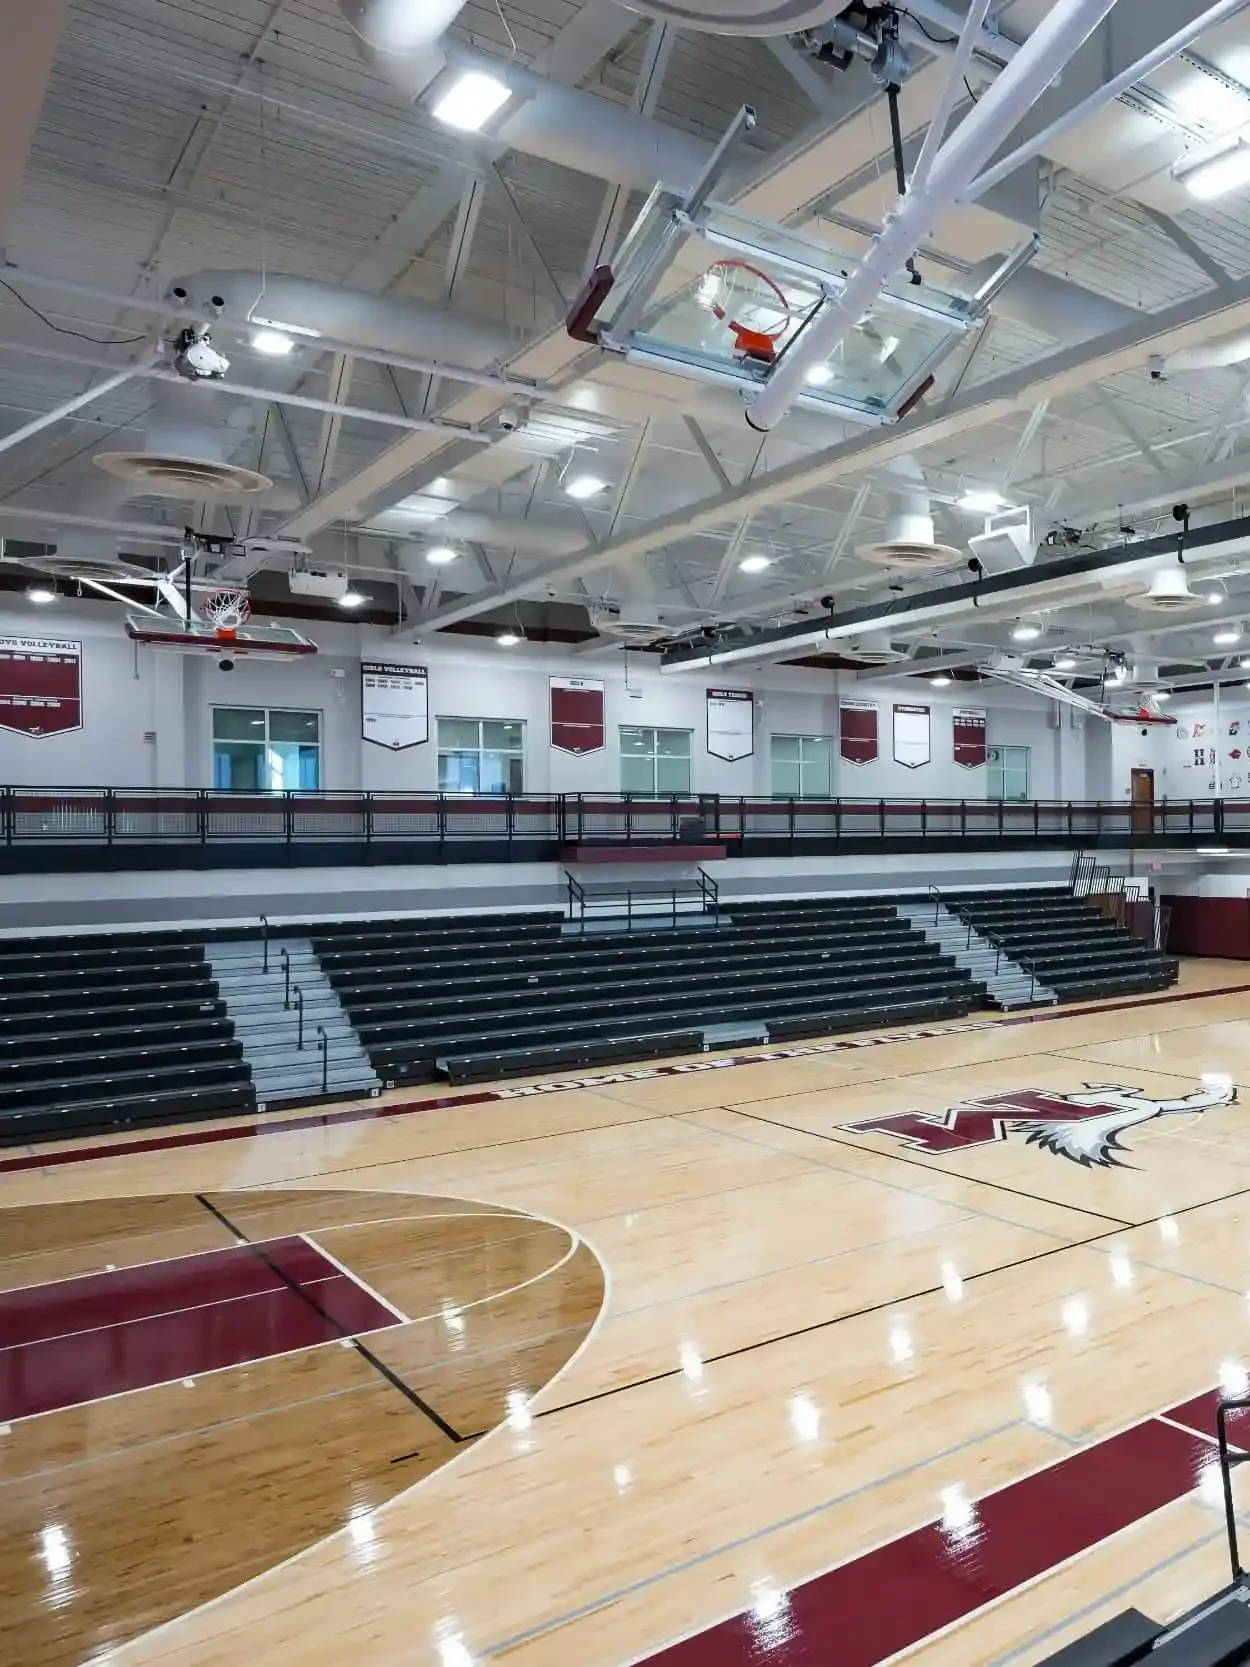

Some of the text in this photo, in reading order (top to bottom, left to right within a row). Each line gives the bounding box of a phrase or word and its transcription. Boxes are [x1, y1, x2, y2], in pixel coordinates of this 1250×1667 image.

[494, 1068, 669, 1100] HOME
[672, 1058, 737, 1072] OF
[744, 1043, 852, 1061] THE
